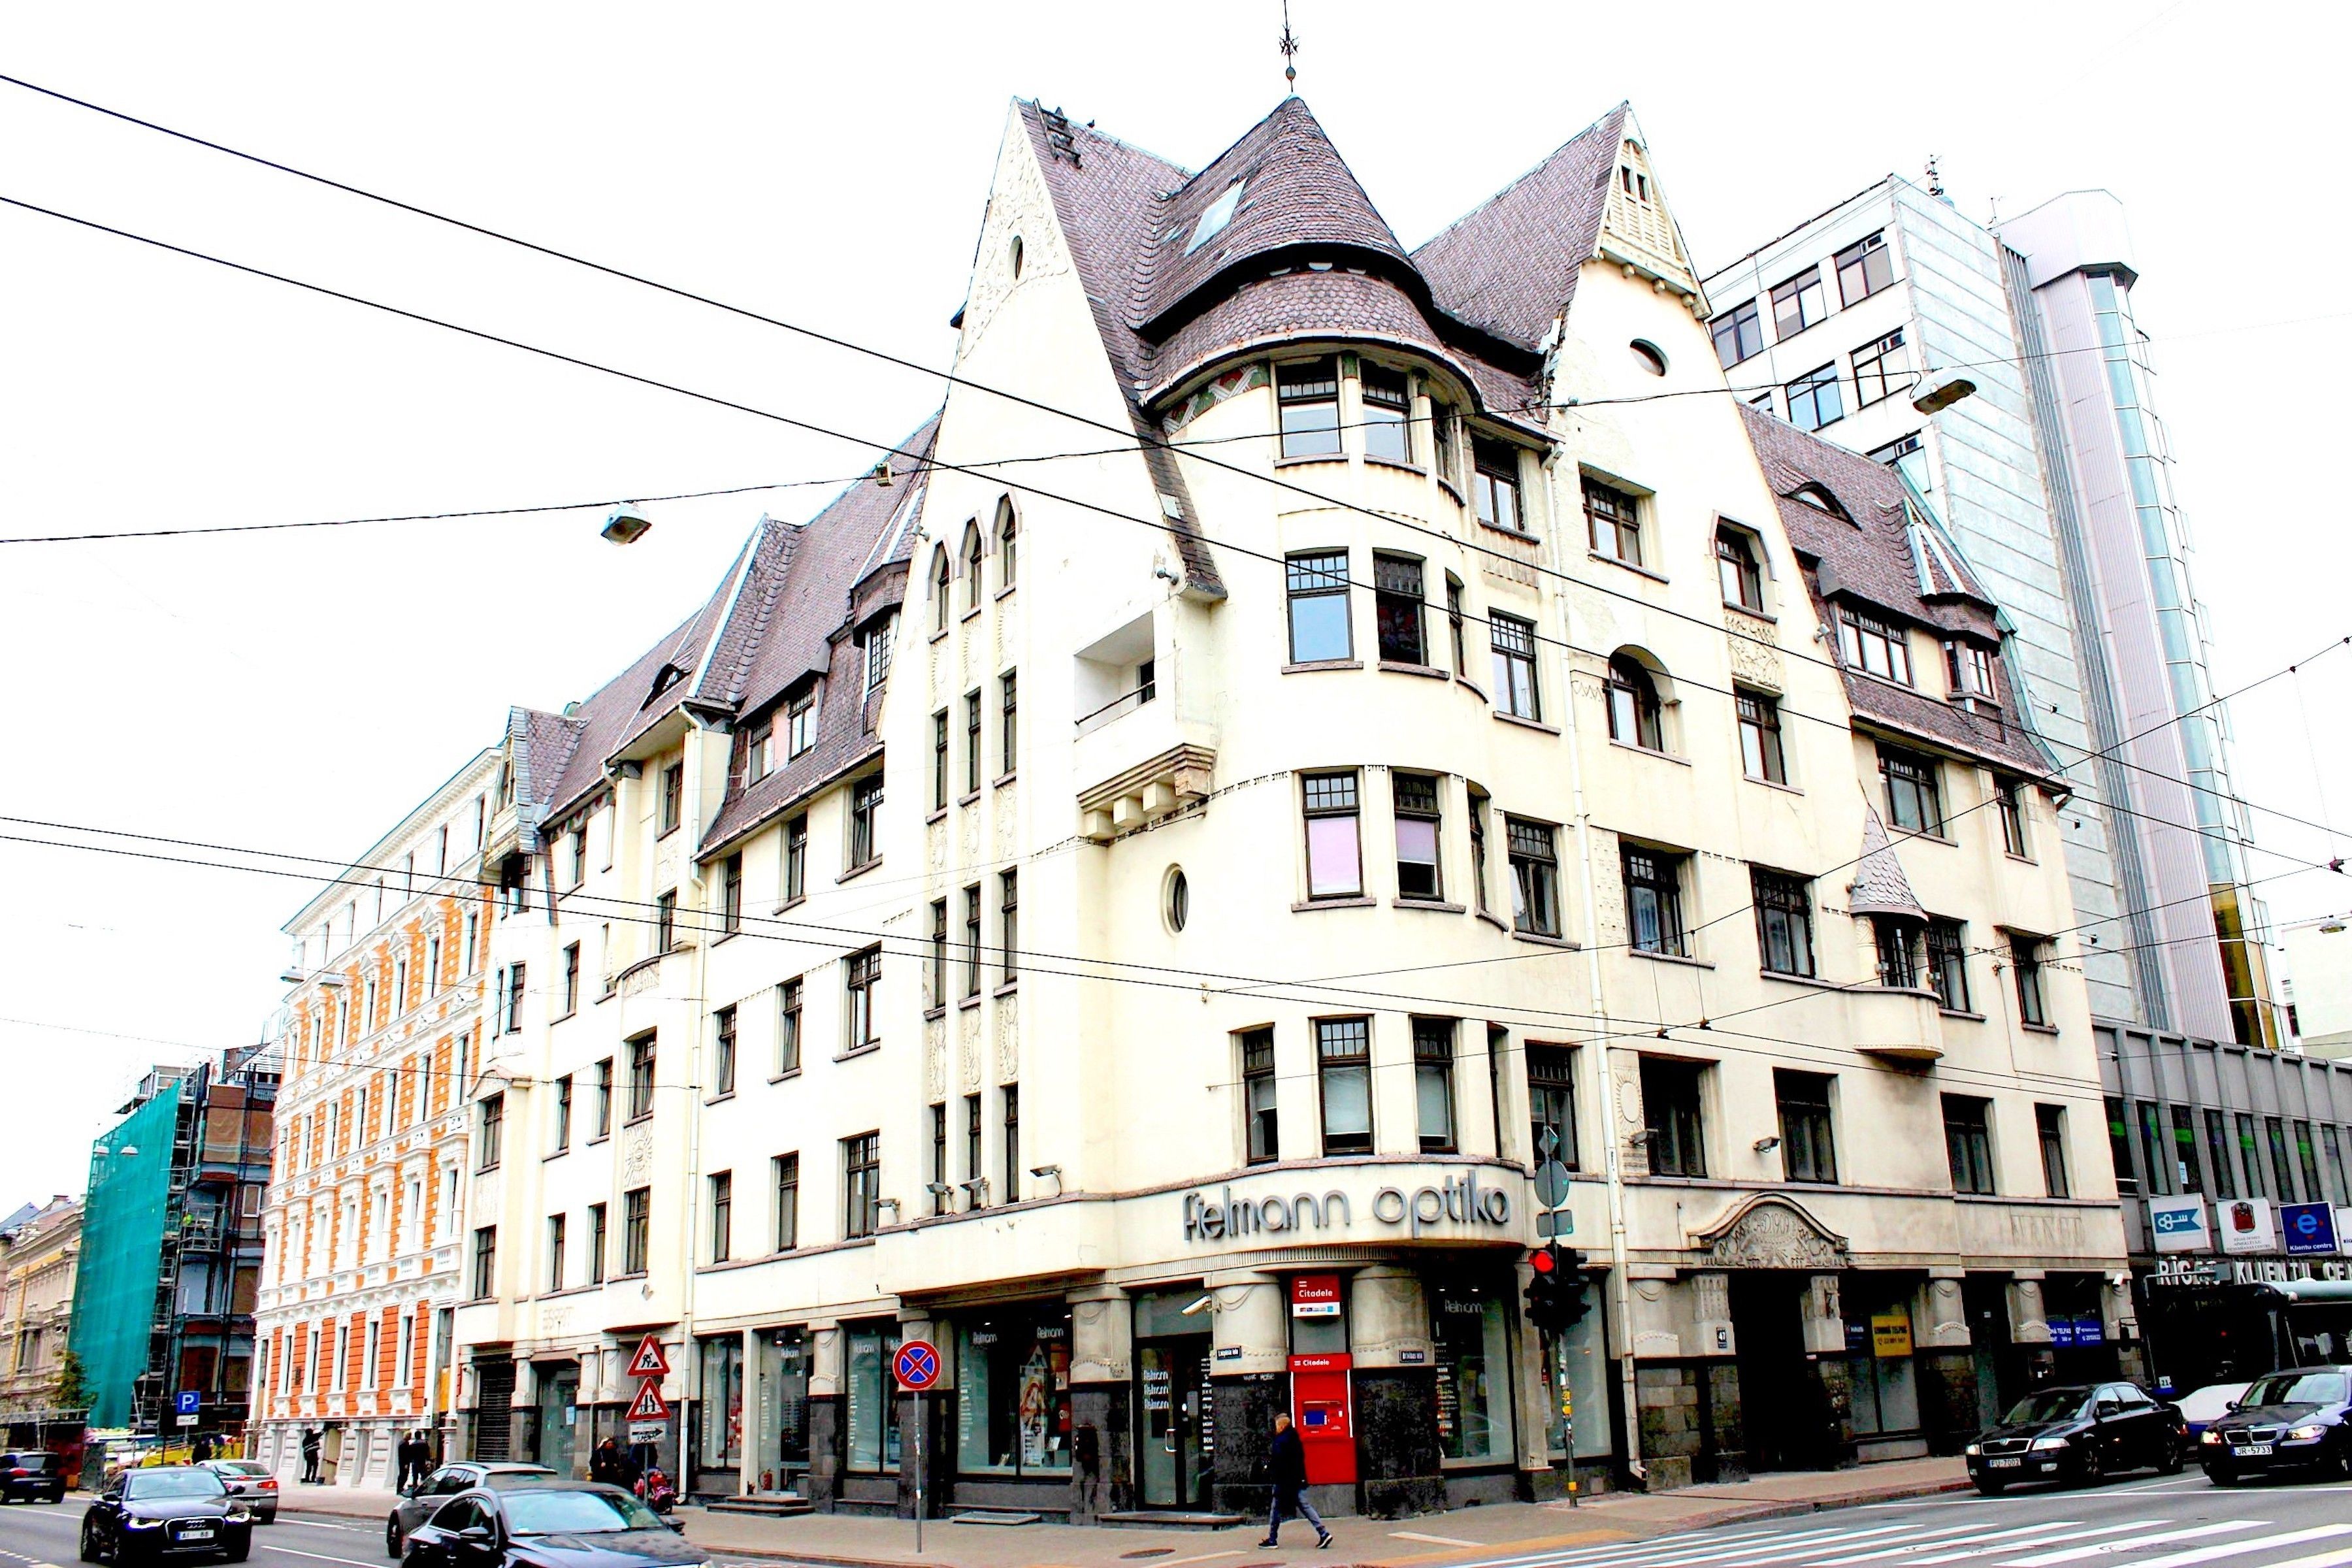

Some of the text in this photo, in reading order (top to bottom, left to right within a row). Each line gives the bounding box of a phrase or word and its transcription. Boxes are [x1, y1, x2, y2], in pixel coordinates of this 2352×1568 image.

[1182, 1169, 1510, 1241] fielmann optika
[1298, 1288, 1333, 1298] Citadele
[182, 1394, 194, 1411] P
[2237, 1446, 2271, 1455] JR-5733
